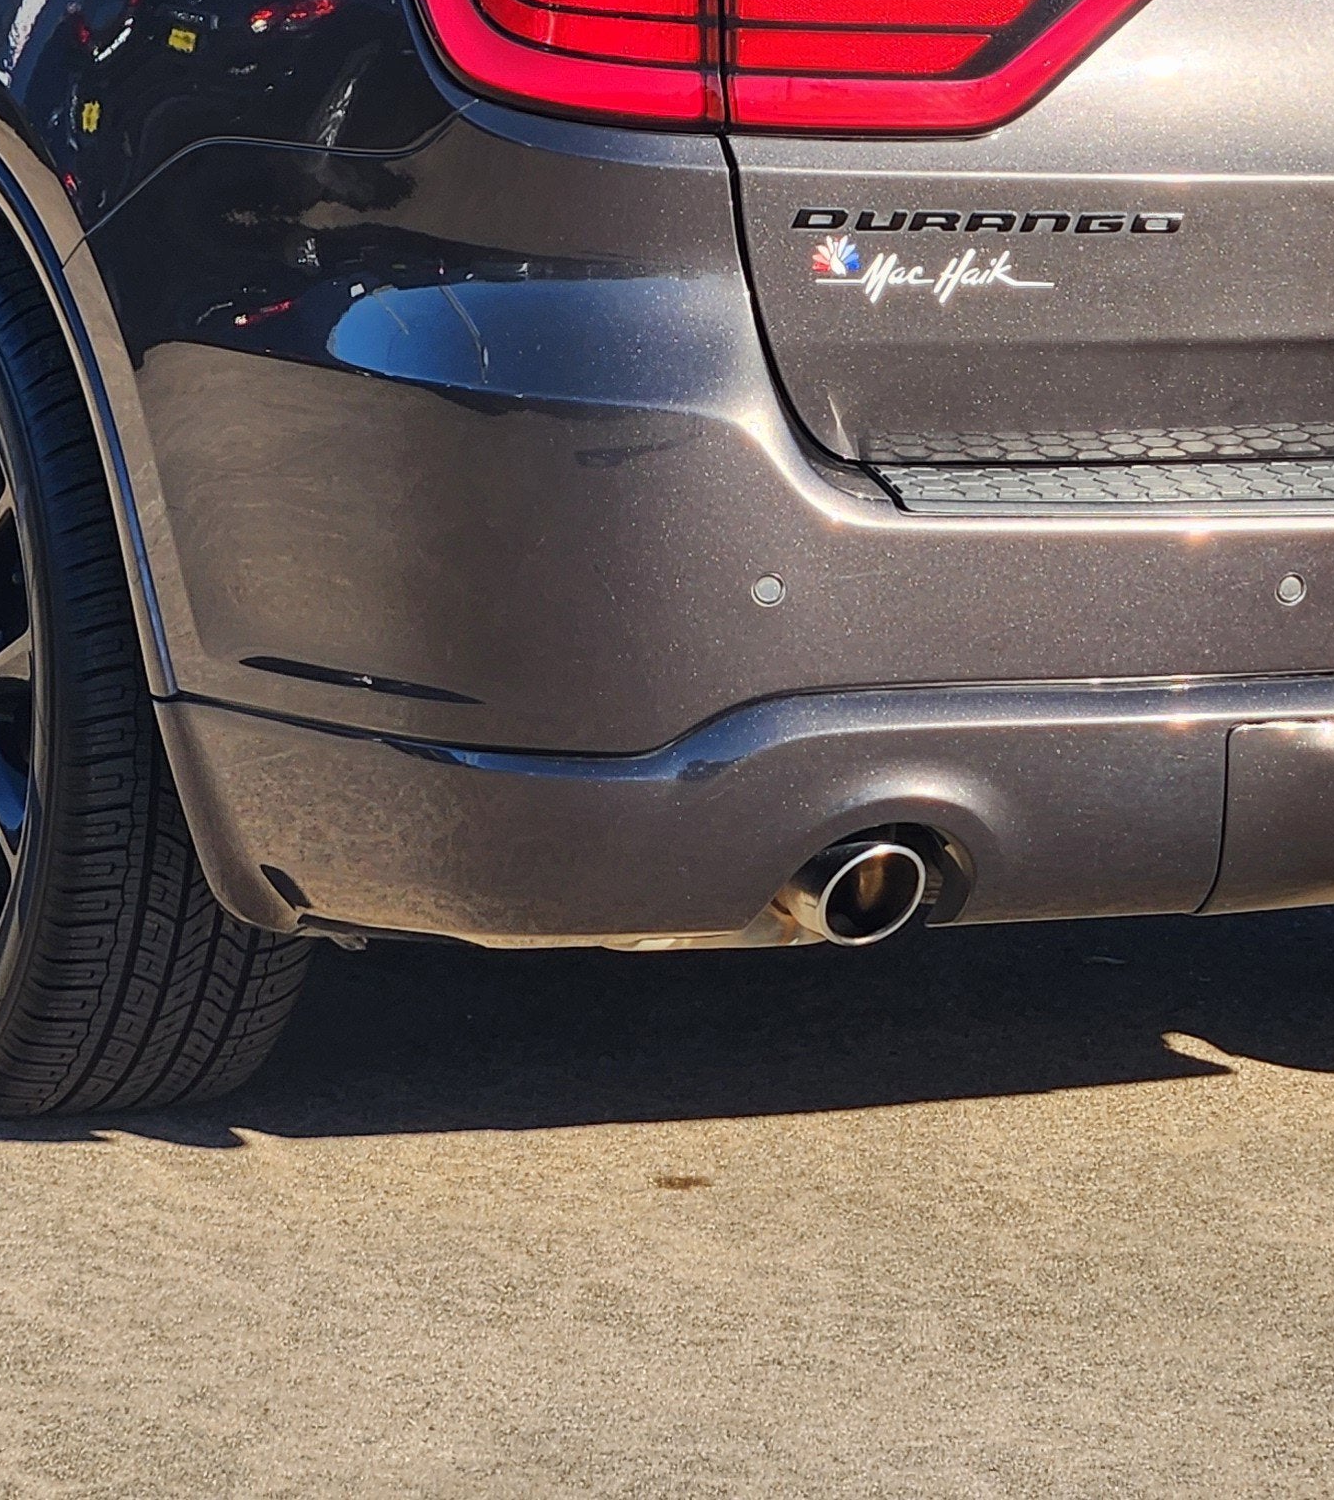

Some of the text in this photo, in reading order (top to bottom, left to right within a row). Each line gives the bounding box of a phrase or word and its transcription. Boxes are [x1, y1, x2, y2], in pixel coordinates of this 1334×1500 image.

[789, 206, 1186, 235] DURANGO
[860, 247, 1055, 305] Mac Haik
